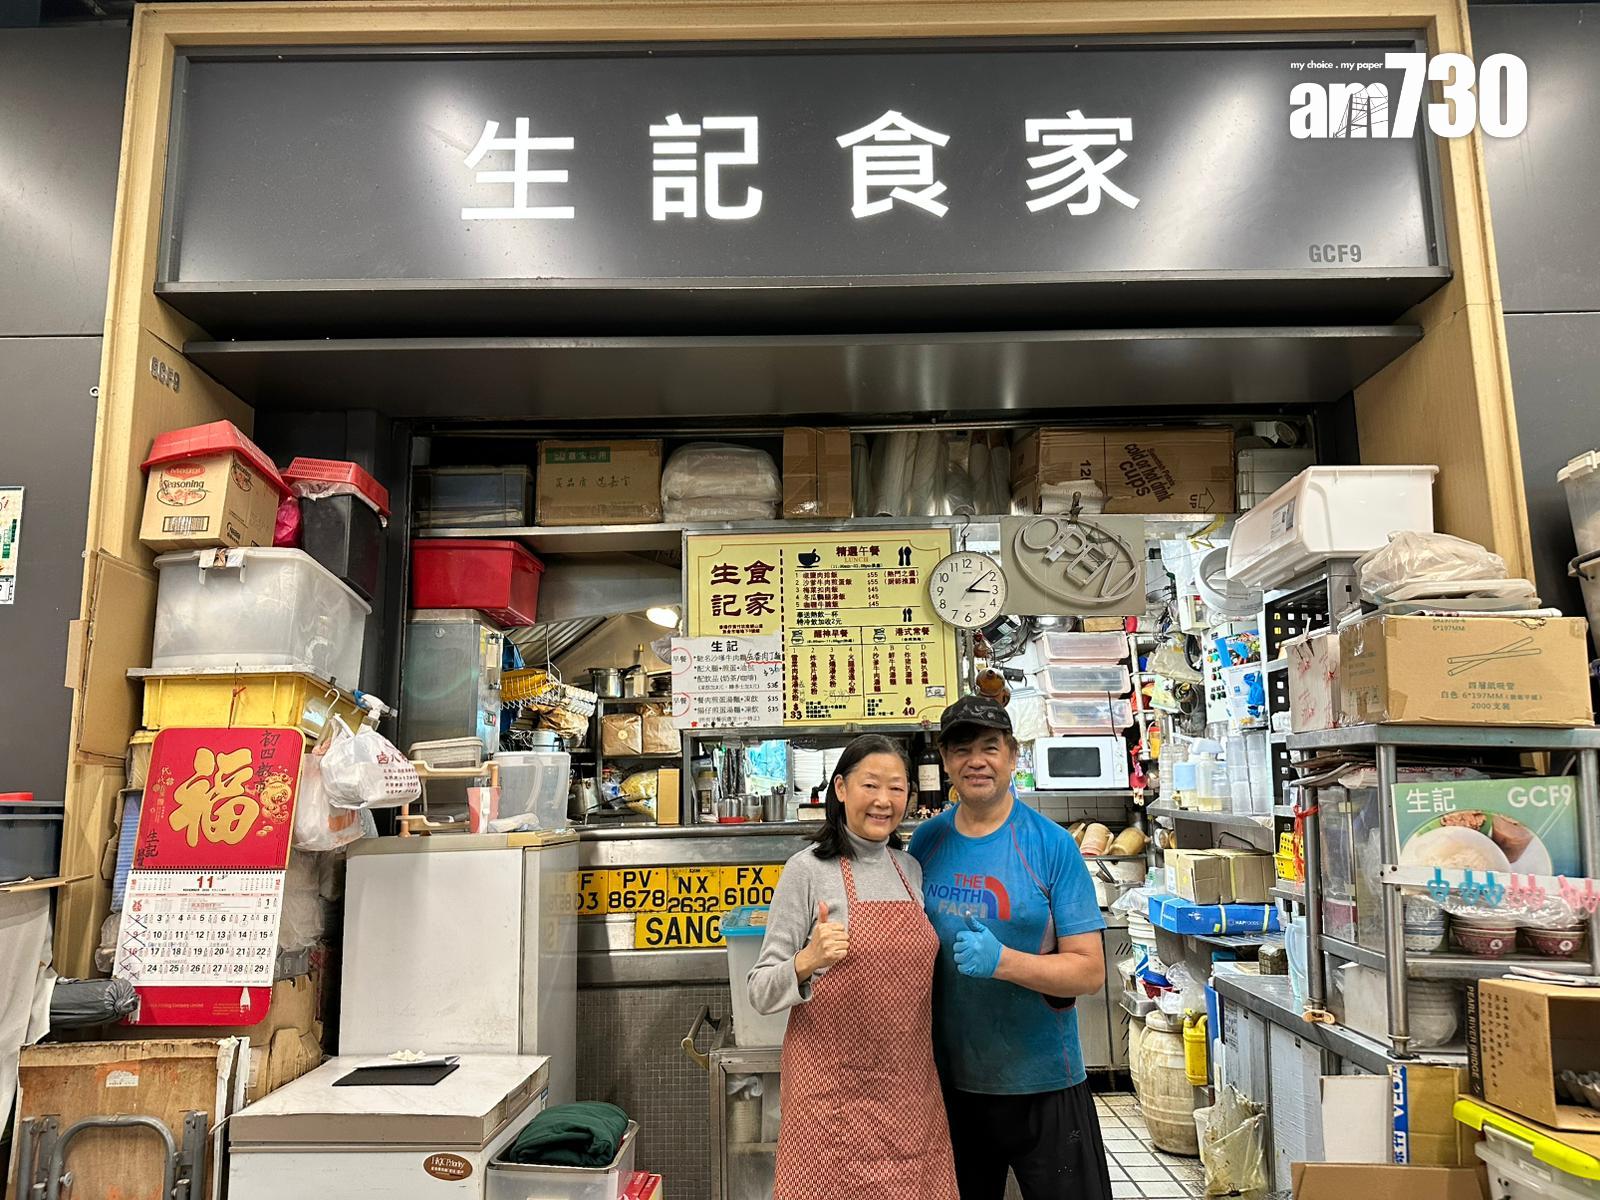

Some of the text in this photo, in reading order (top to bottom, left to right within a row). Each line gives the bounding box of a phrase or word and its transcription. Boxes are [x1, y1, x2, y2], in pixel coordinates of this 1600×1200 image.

[461, 110, 1141, 221] 生記食家
[1309, 245, 1362, 263] GCF9
[1124, 443, 1149, 461] cold
[162, 480, 205, 489] Seasoning
[1119, 461, 1150, 497] cups
[1189, 494, 1197, 509] UP
[836, 546, 880, 557] 精選午餐
[962, 559, 972, 568] 12
[1023, 517, 1138, 599] OPEN
[950, 563, 958, 572] 11
[939, 573, 949, 582] 10
[990, 572, 996, 581] 2
[937, 586, 944, 596] 9
[992, 585, 998, 594] 3
[939, 599, 946, 609] 8
[989, 599, 996, 607] 4
[952, 610, 958, 619] 7
[965, 613, 972, 622] 6
[979, 609, 986, 618] 5
[895, 627, 930, 637] 港式常餐
[711, 640, 738, 652] 生記
[1441, 690, 1458, 699] 白色
[902, 707, 915, 716] 40
[169, 747, 260, 848] 福
[1406, 787, 1456, 813] 生記
[1507, 784, 1573, 808] GCF9
[196, 875, 213, 888] 11
[623, 870, 652, 888] PV
[737, 867, 764, 885] FX
[953, 873, 983, 889] THE
[678, 876, 708, 894] NX
[608, 889, 665, 909] 8678
[724, 886, 774, 905] 6100
[926, 884, 981, 903] NORTH
[667, 896, 719, 912] 2632
[157, 914, 162, 922] 3
[178, 914, 183, 922] 4
[200, 914, 204, 922] 5
[221, 914, 226, 922] 6
[242, 914, 247, 922] 7
[263, 914, 268, 922] 8
[153, 931, 162, 939] 10
[175, 931, 184, 939] 11
[196, 931, 204, 939] 12
[217, 931, 226, 939] 13
[238, 931, 247, 939] 14
[259, 931, 268, 939] 15
[150, 947, 159, 955] 17
[172, 947, 181, 955] 18
[193, 947, 202, 955] 19
[214, 947, 224, 955] 20
[236, 947, 245, 955] 21
[256, 947, 266, 955] 22
[147, 964, 264, 972] 24 25 26 27 28 29
[1467, 986, 1479, 1078] PEARL RIVER BRIDGE
